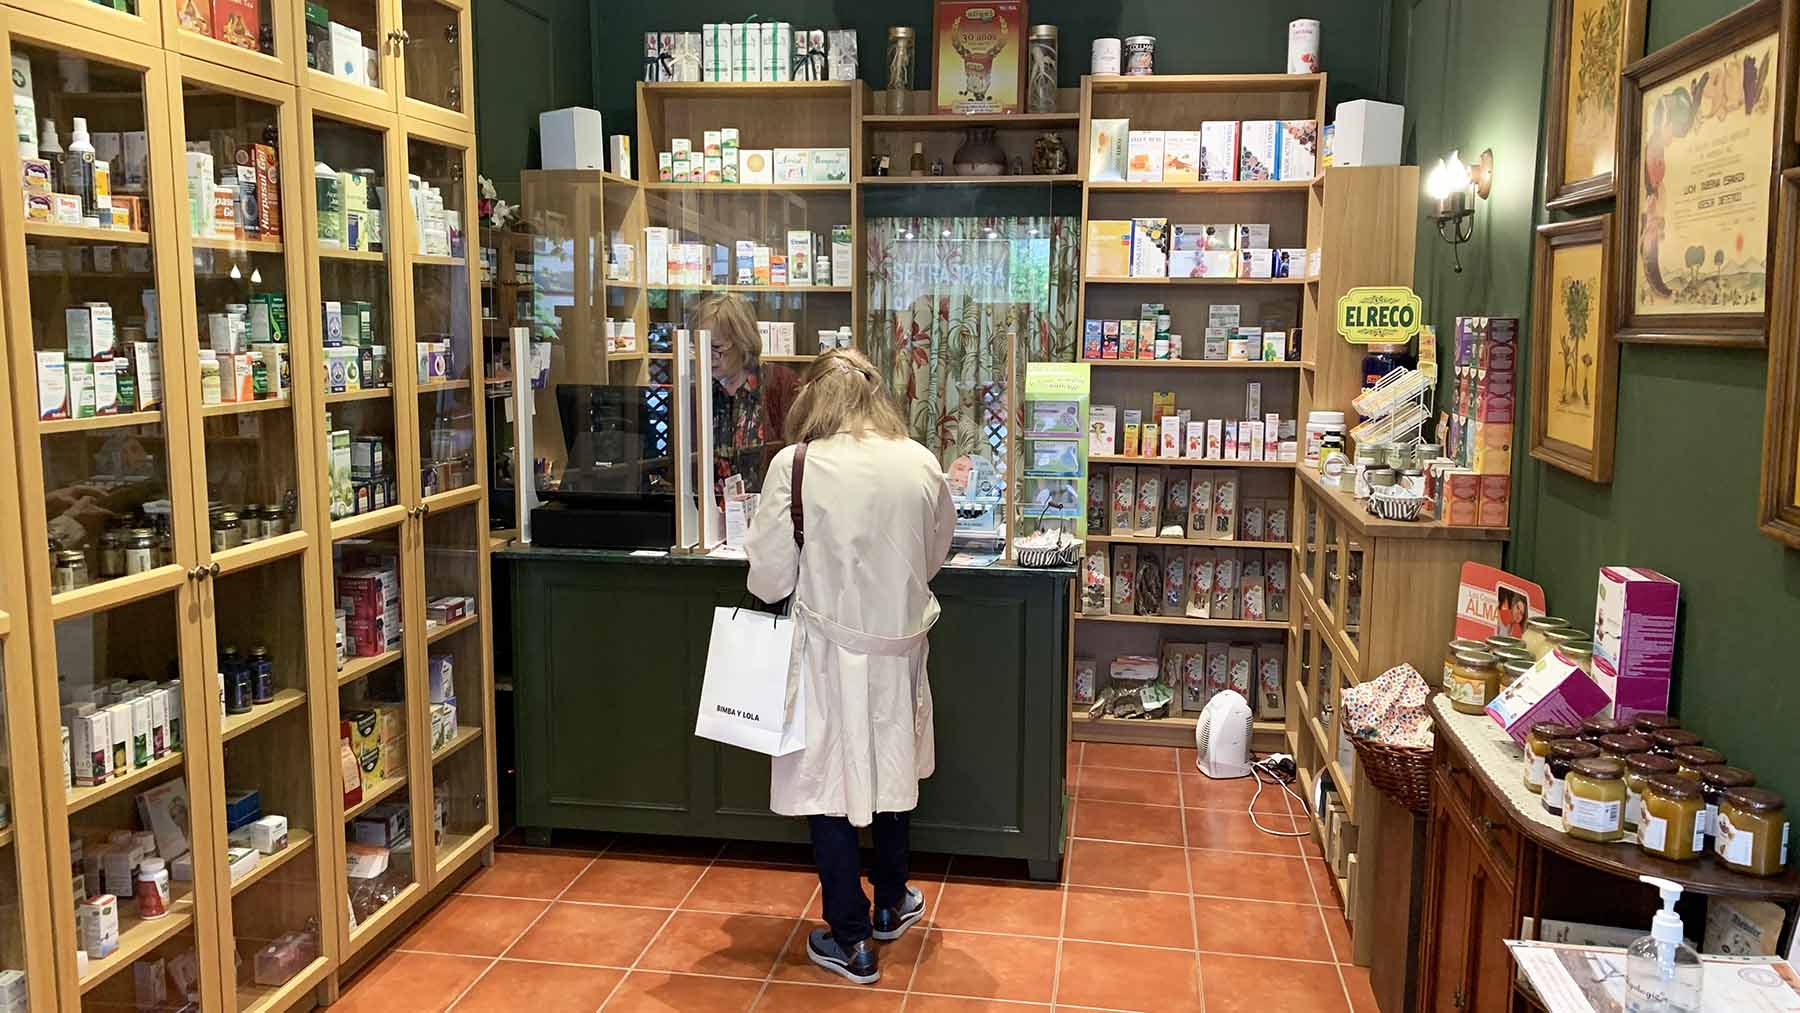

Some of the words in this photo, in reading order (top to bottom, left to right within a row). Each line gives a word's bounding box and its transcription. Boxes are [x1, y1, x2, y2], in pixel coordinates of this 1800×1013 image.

[261, 172, 270, 230] Harpasul
[1345, 306, 1365, 327] EL
[1366, 303, 1414, 328] RECÓ
[716, 704, 735, 716] BIMBA
[743, 712, 760, 721] LOLA
